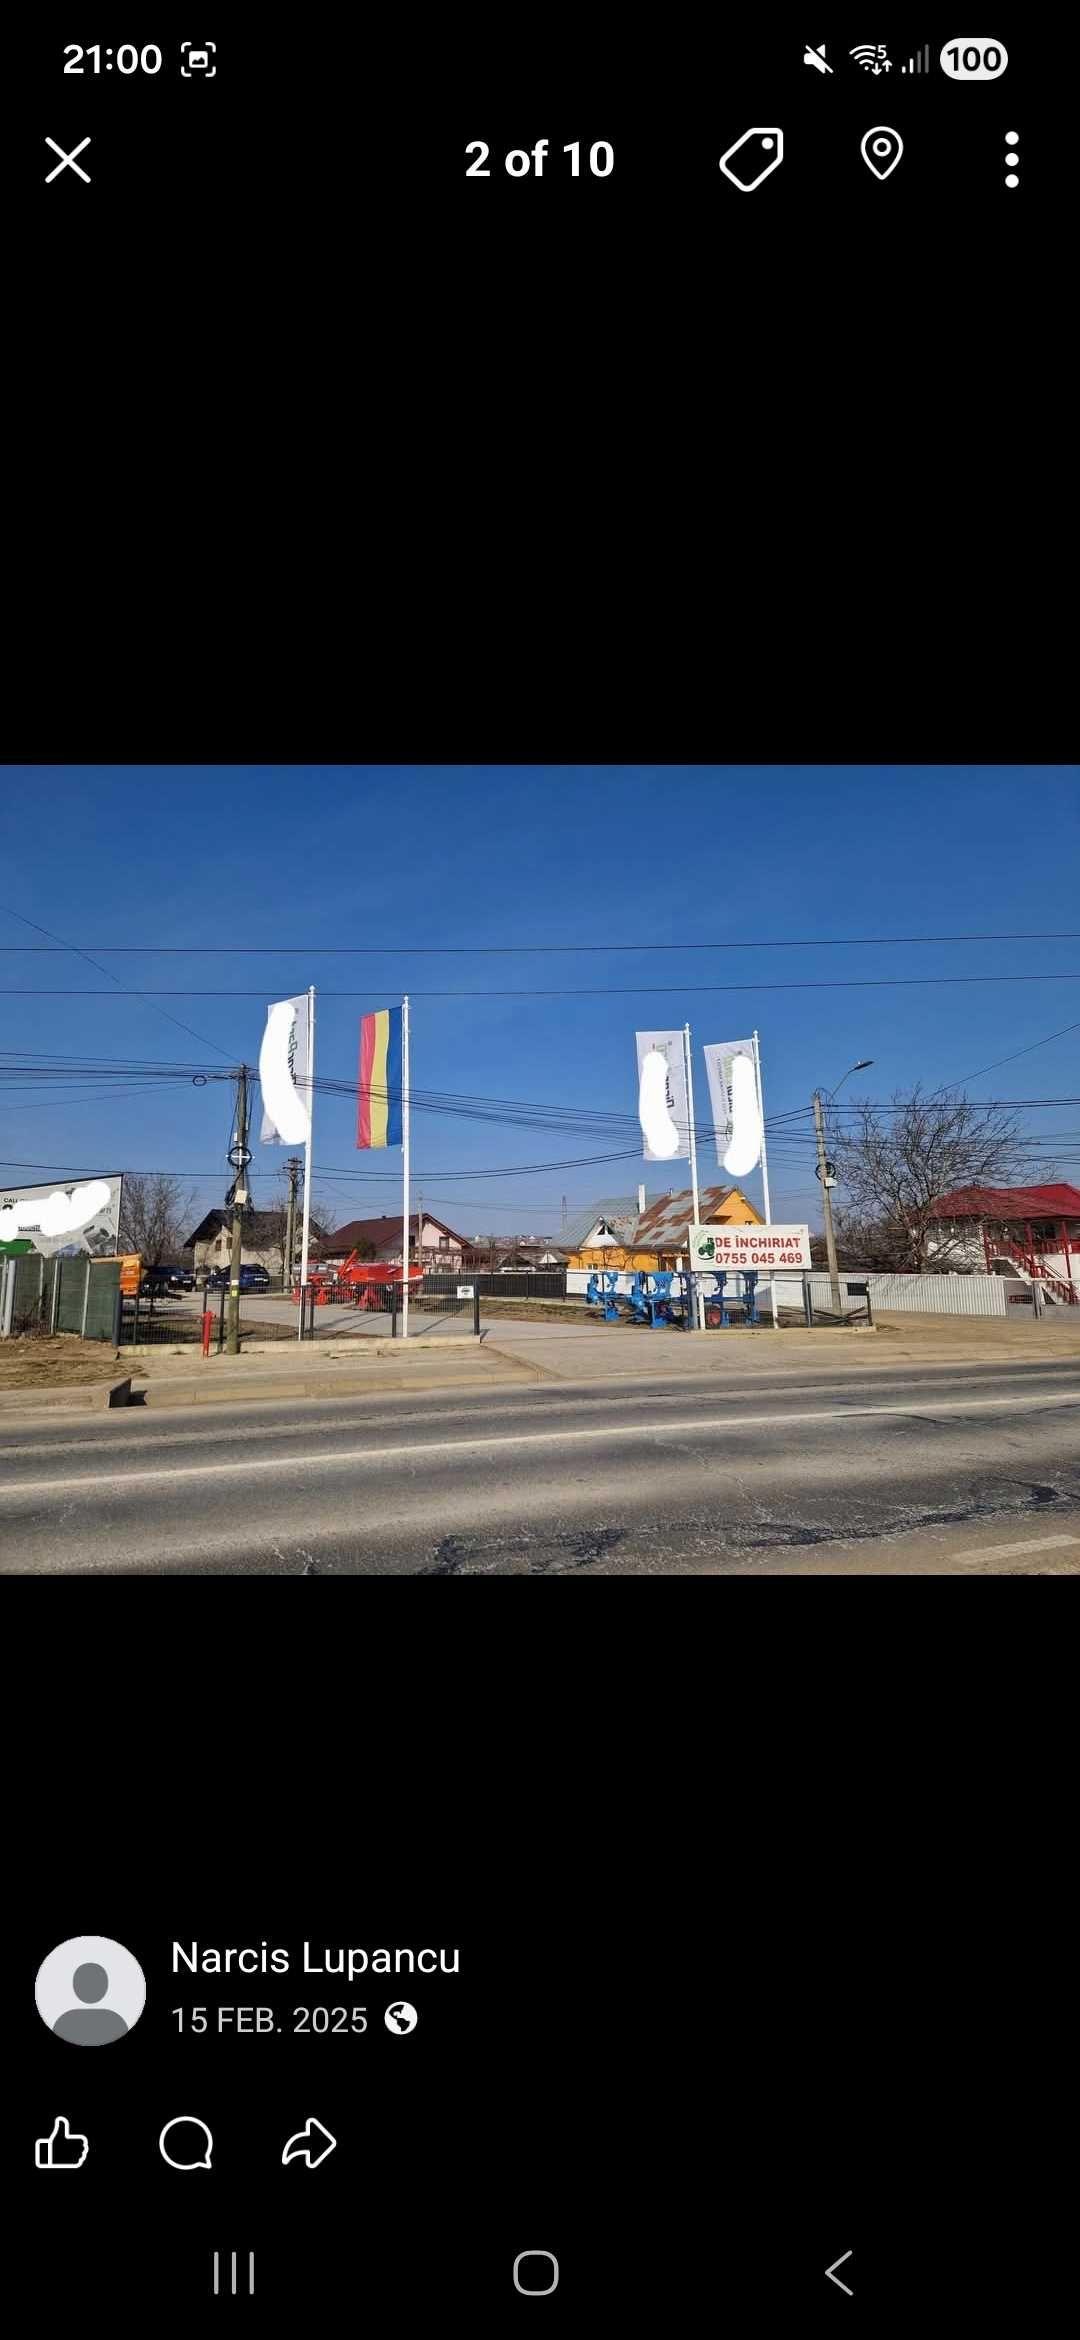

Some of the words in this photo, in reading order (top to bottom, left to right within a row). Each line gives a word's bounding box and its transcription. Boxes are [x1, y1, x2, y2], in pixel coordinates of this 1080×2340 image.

[716, 1238, 731, 1248] DE
[716, 1252, 747, 1264] 0755
[751, 1252, 775, 1264] 045
[779, 1252, 803, 1264] 469
